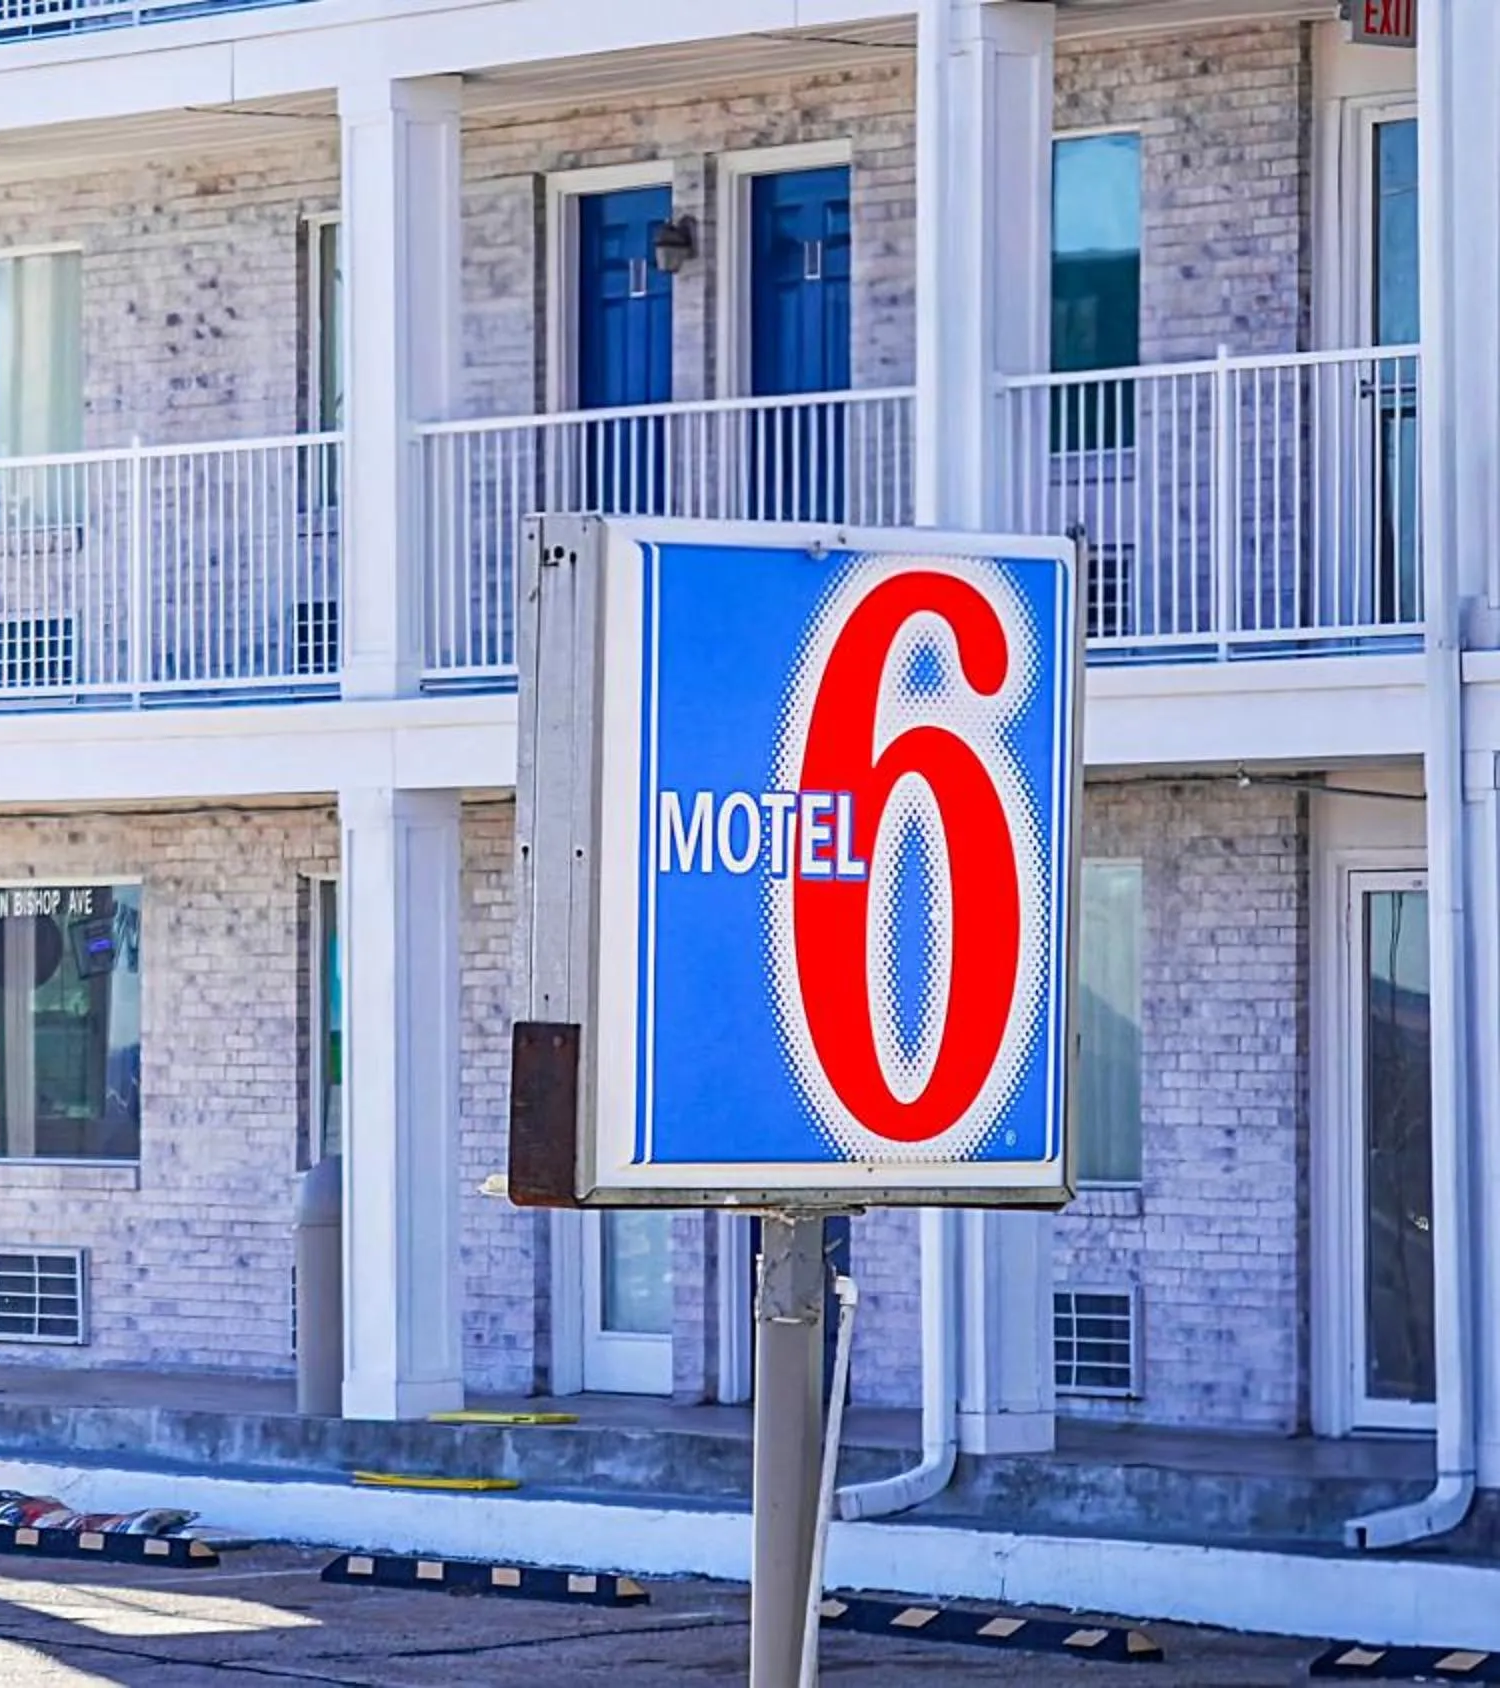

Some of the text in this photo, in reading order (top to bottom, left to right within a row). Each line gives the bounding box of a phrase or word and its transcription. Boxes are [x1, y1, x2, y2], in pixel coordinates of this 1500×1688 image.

[0, 891, 9, 918] N
[13, 889, 60, 916] BISHOP
[69, 889, 93, 914] AVE
[657, 570, 1020, 1143] MOTEL 6
